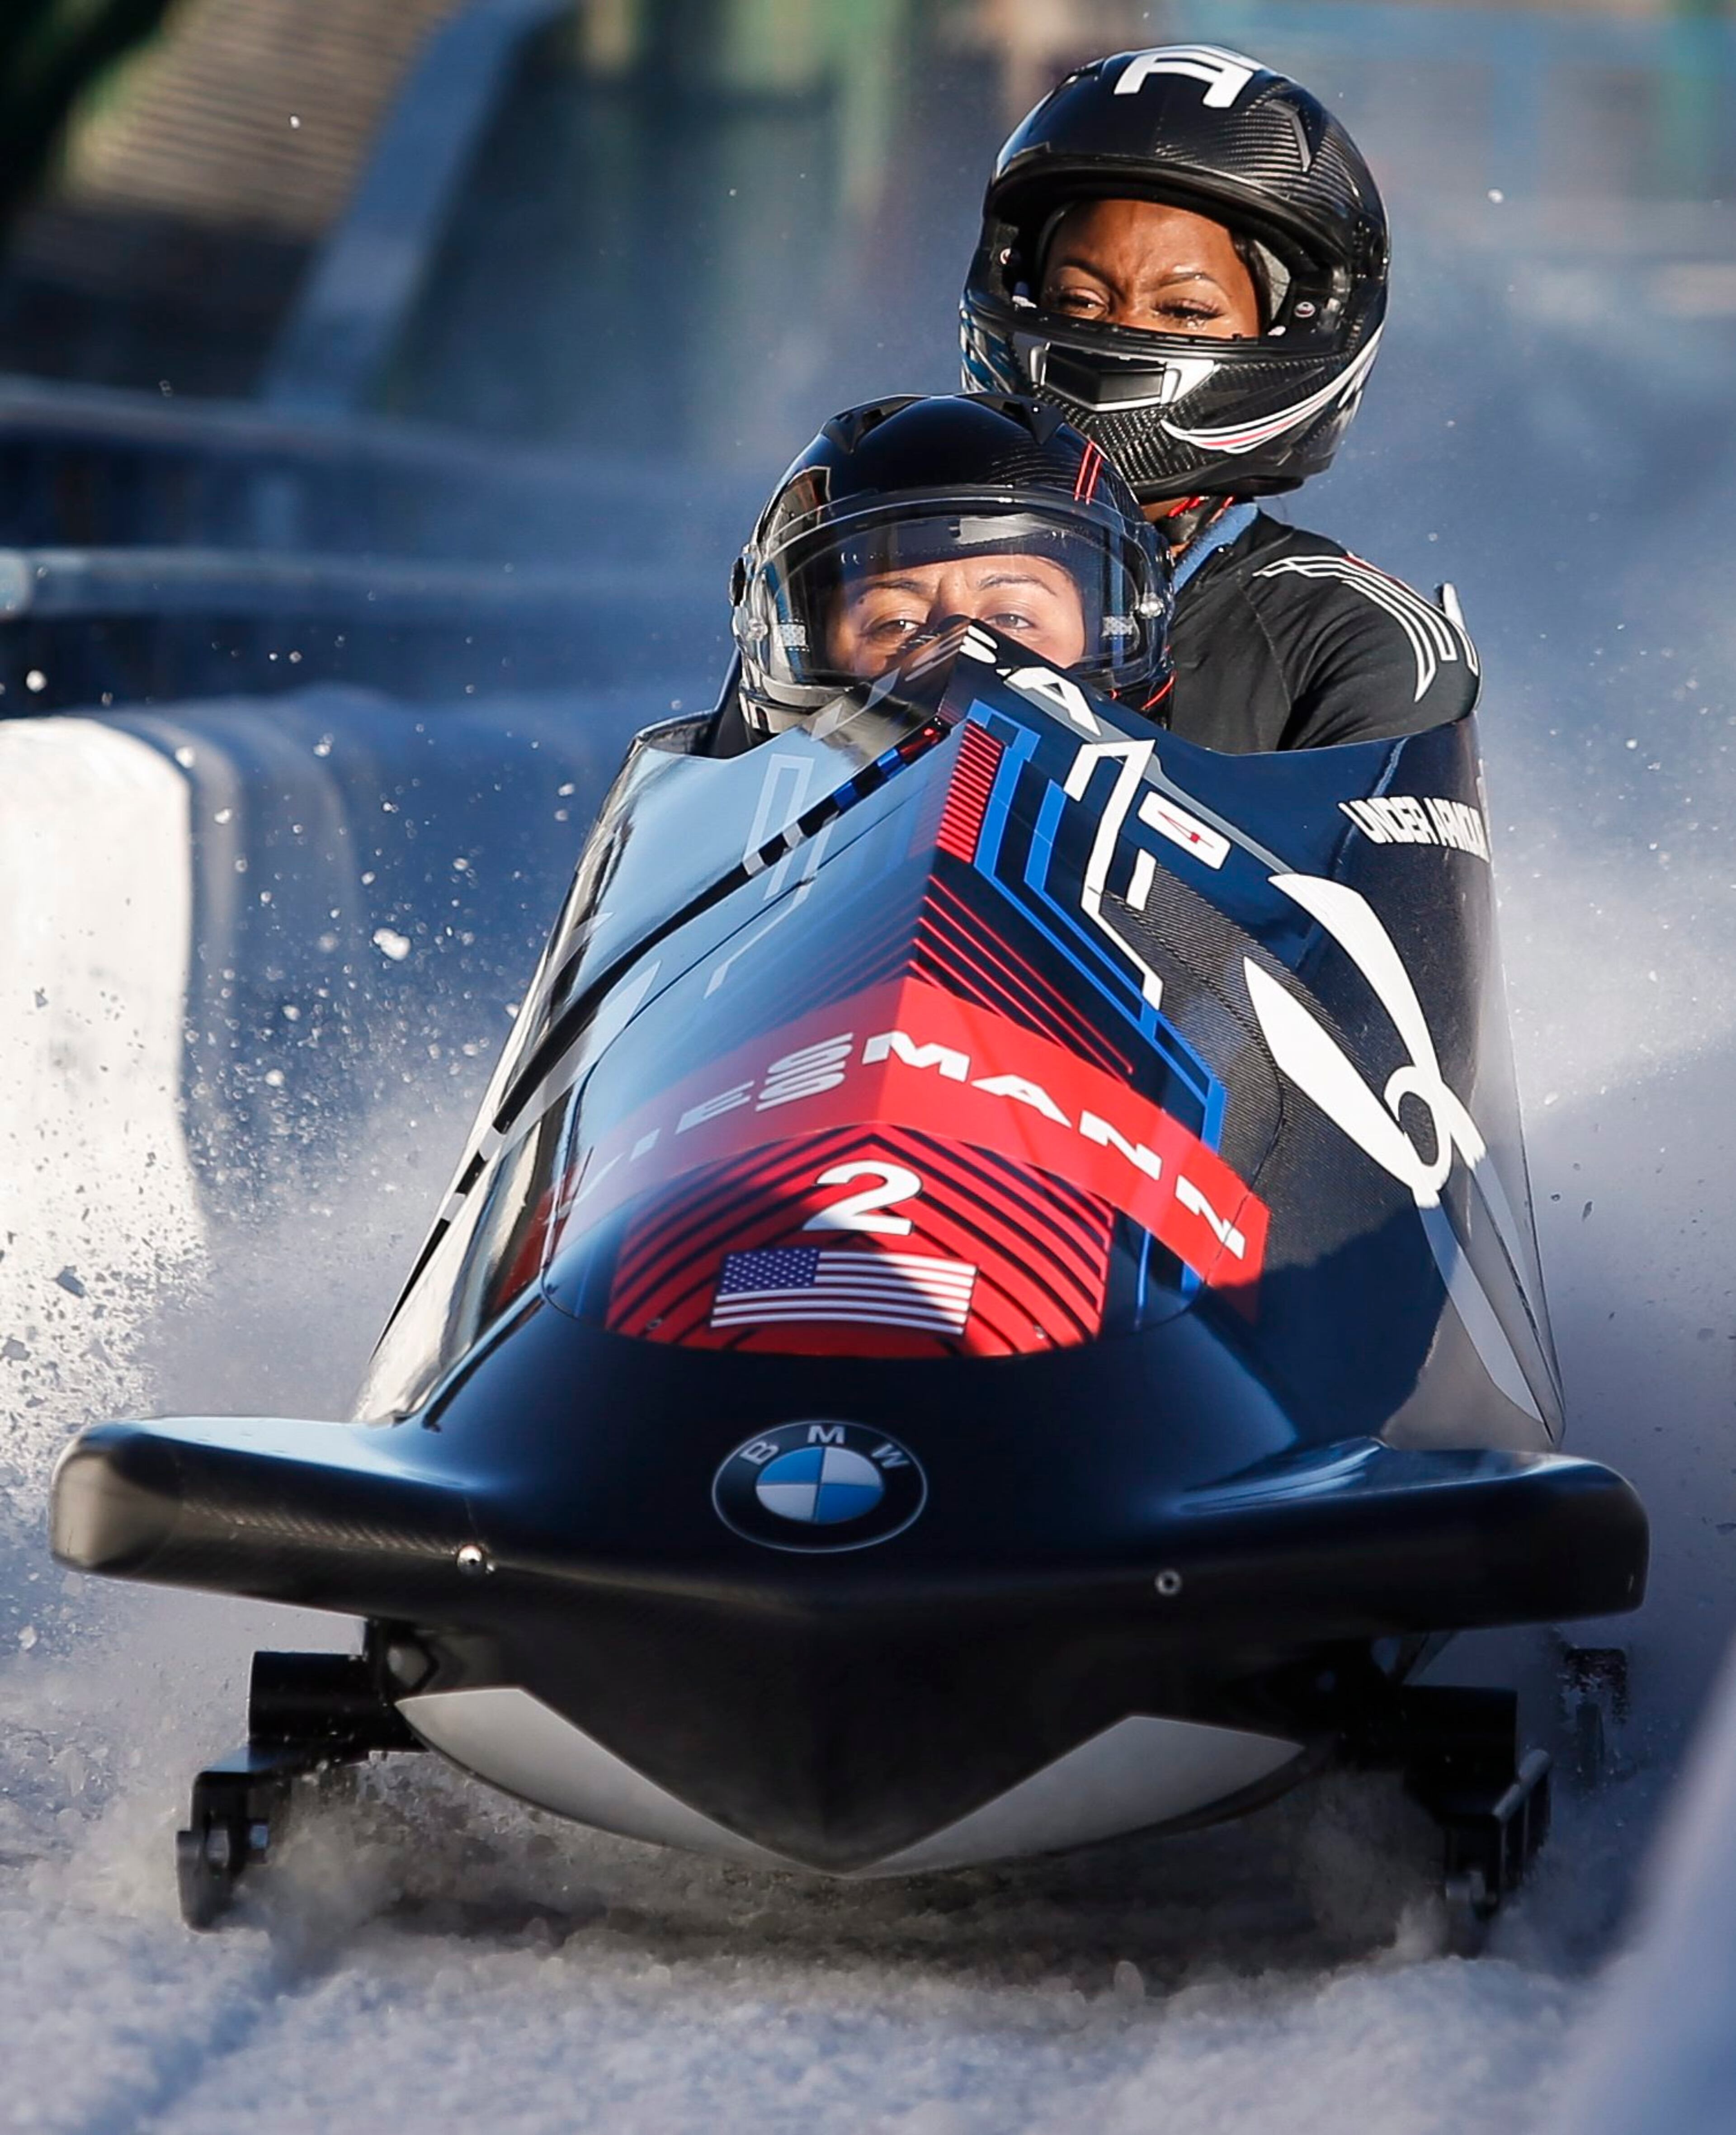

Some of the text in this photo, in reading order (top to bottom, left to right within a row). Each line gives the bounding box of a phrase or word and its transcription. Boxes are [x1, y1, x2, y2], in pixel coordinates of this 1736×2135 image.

[1337, 795, 1439, 845] UNDER
[802, 1159, 923, 1237] 2
[739, 1424, 910, 1470] BMW
